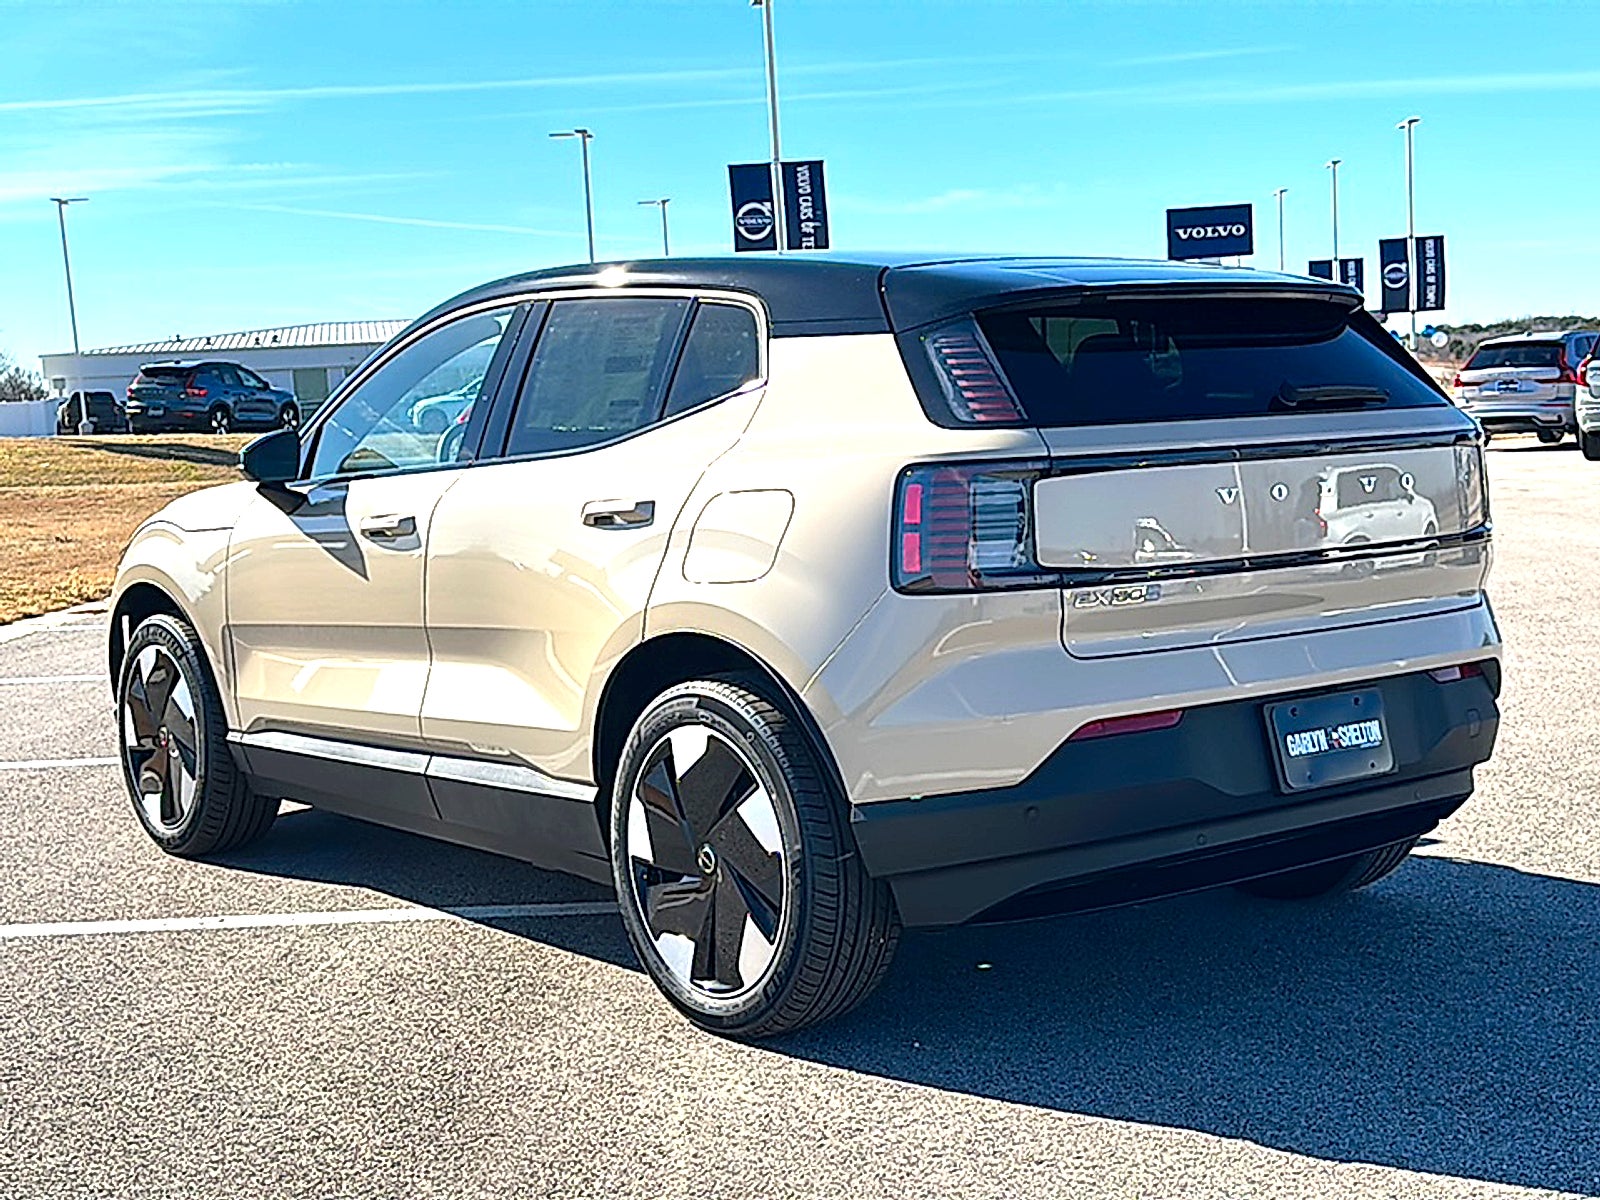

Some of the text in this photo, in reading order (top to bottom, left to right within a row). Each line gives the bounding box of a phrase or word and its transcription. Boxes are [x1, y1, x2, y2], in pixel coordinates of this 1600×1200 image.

[796, 165, 811, 194] VOLVO
[798, 196, 814, 220] CARS
[1174, 224, 1246, 240] VOLVO
[1215, 472, 1415, 504] VOLVO
[1286, 720, 1383, 757] GARLYN SHELTON
